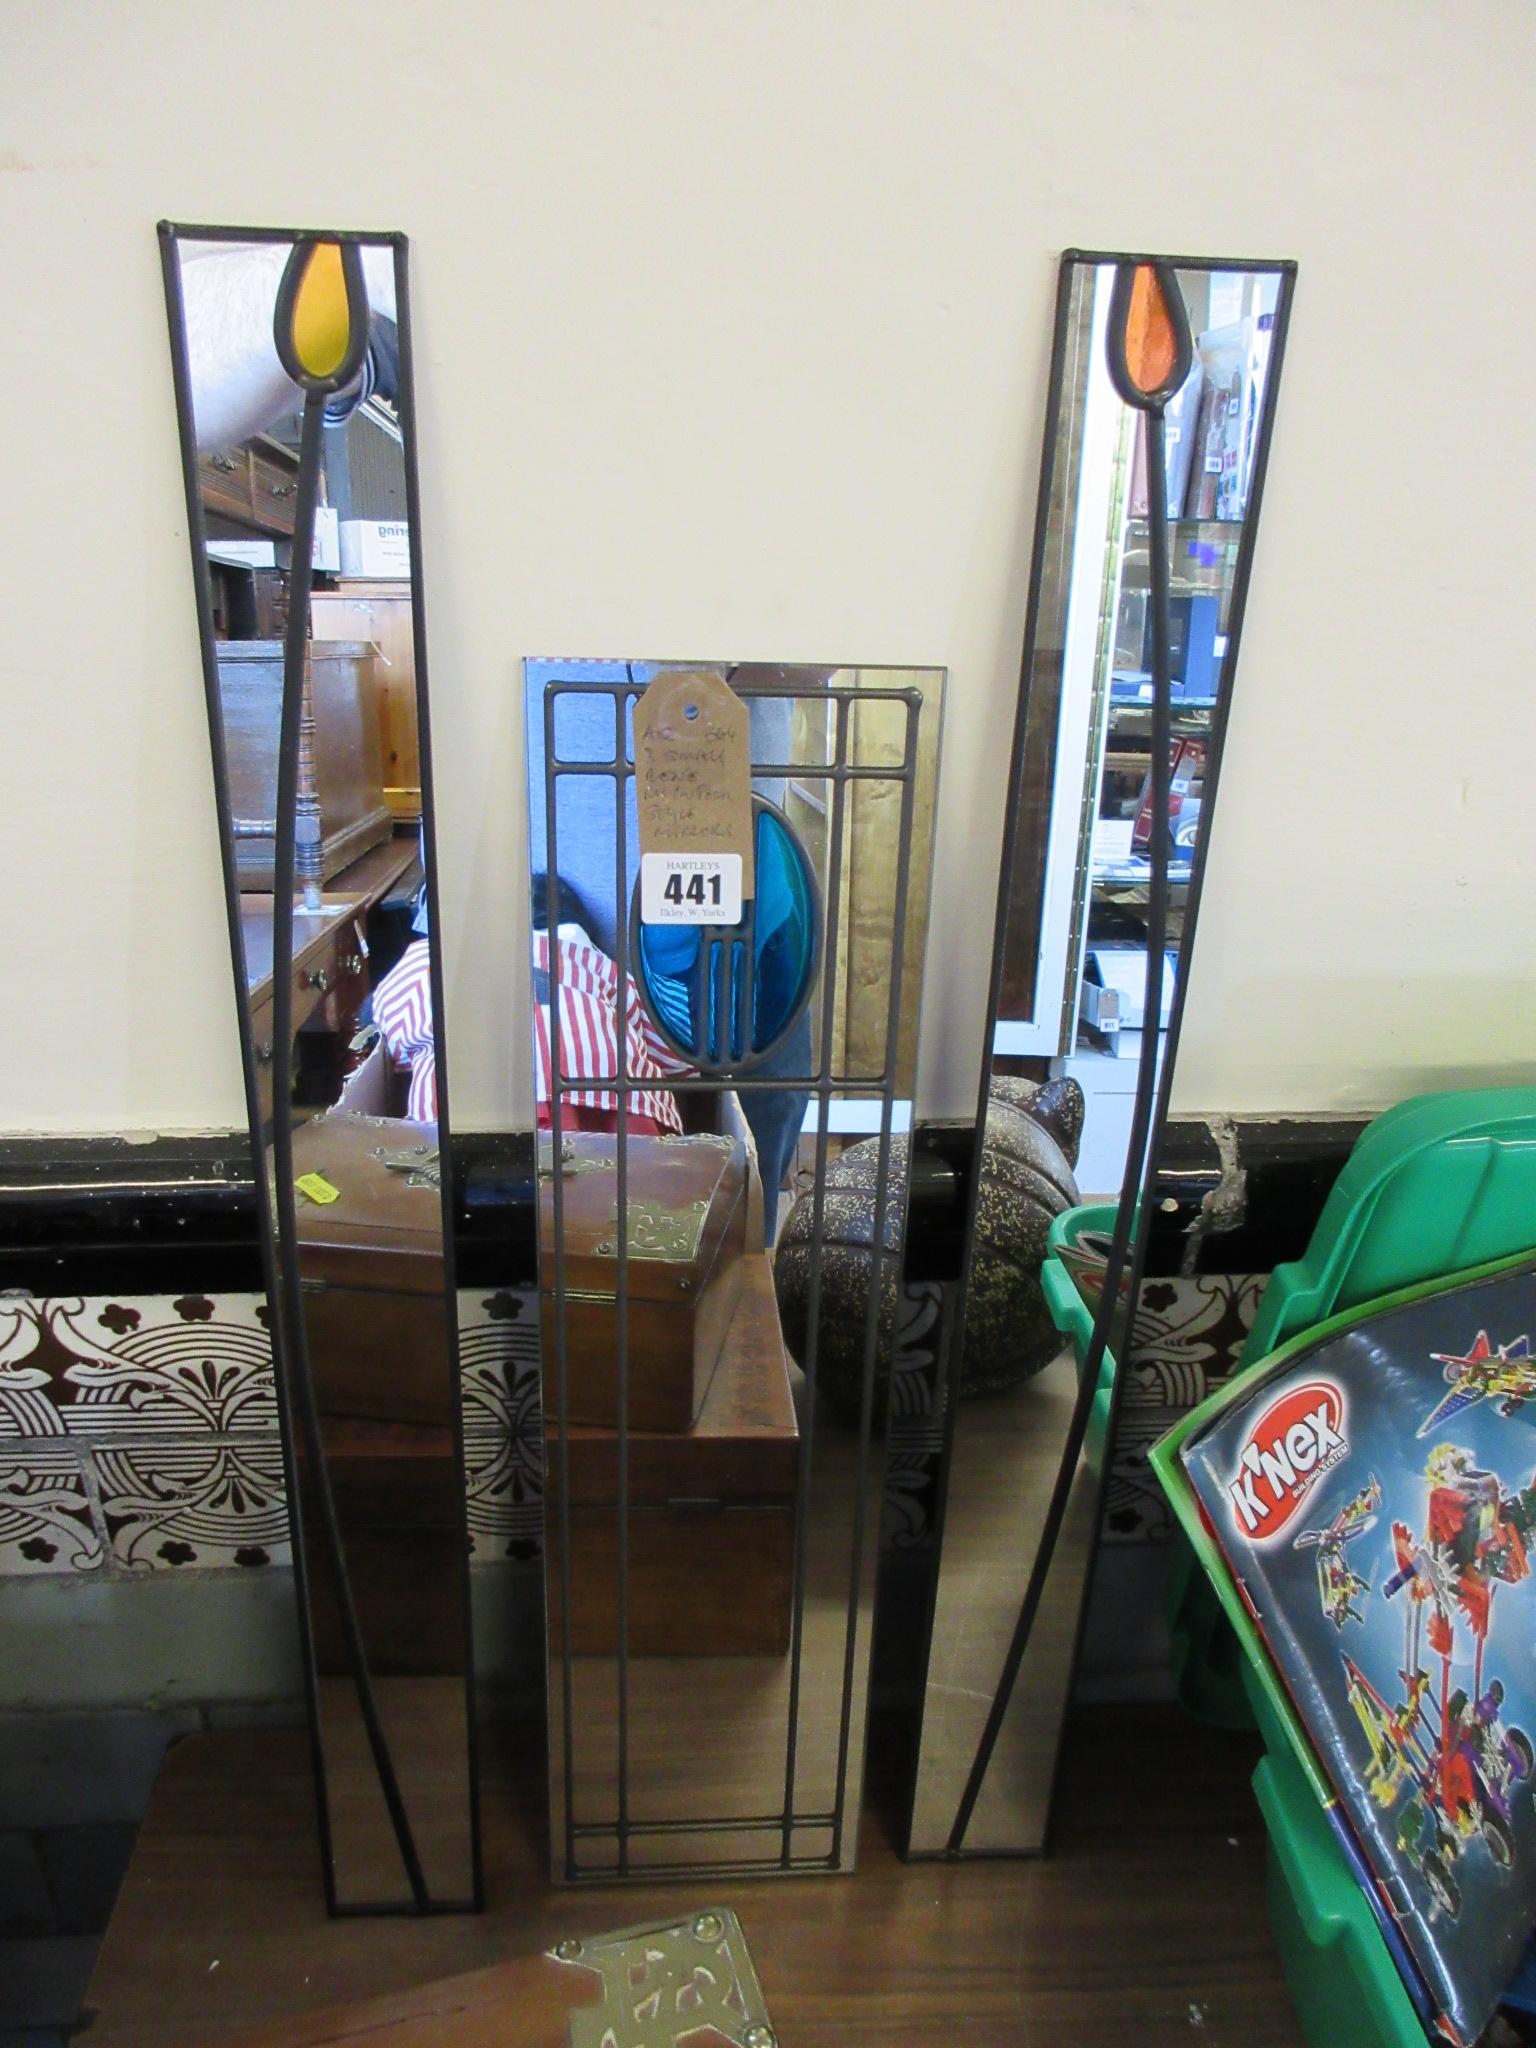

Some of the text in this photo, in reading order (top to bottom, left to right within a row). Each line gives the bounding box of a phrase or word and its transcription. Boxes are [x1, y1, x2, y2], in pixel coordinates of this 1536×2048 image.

[666, 861, 720, 870] HARTLEYS
[664, 873, 721, 905] 441
[660, 907, 687, 918] Ilkley,
[702, 908, 726, 917] Yorks
[1320, 1443, 1349, 1473] SYSTEM
